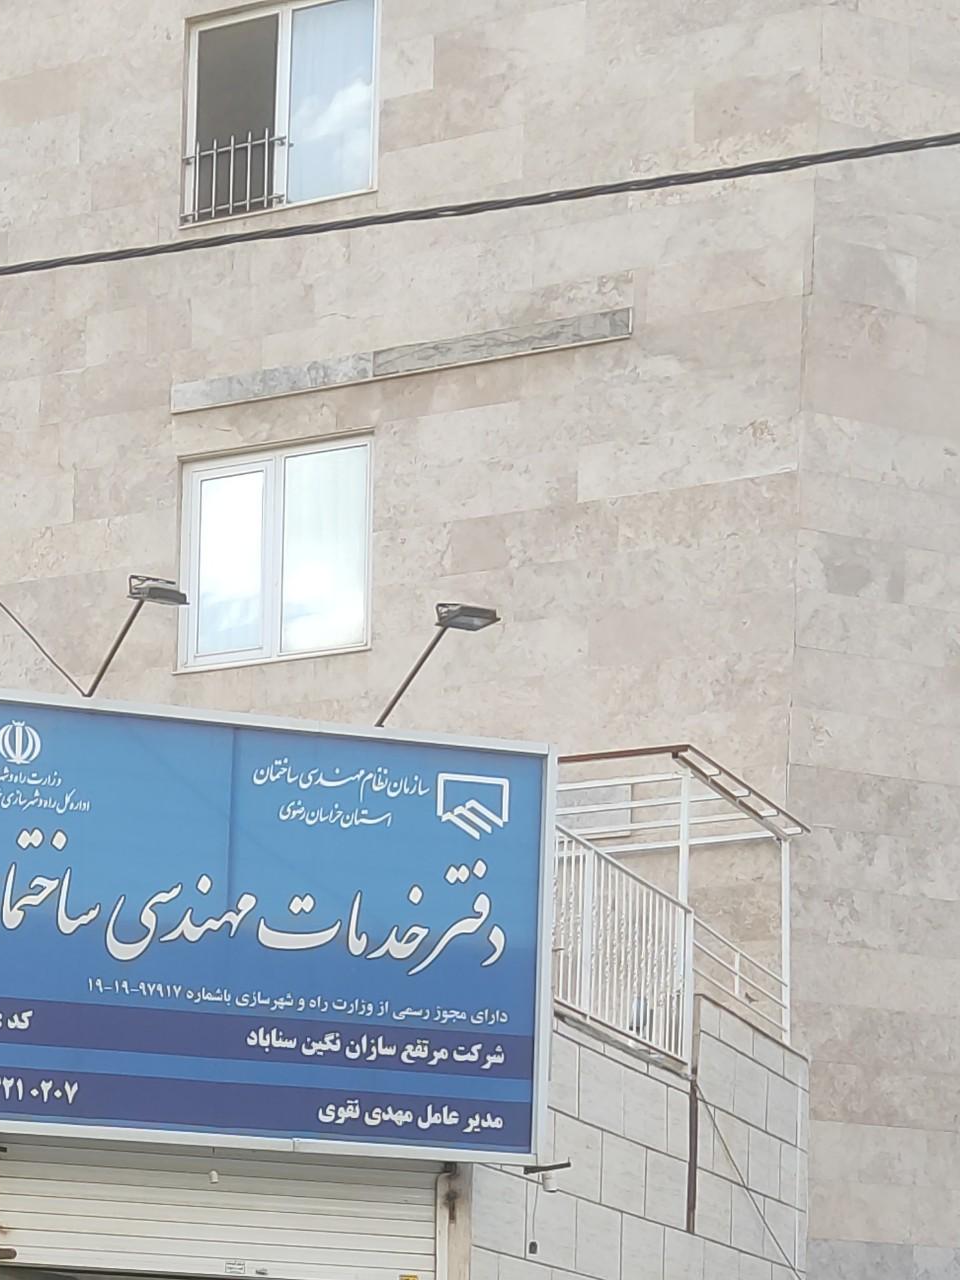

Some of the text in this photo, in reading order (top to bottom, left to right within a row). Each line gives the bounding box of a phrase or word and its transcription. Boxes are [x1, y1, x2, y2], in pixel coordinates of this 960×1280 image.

[253, 758, 430, 803] سازمان نظام مهندسی ساختمان
[279, 800, 391, 828] استان خراسان رضوی
[106, 873, 257, 961] مهندسی
[257, 885, 429, 960] خدمات
[407, 858, 506, 976] دفتر
[297, 997, 305, 1012] و
[309, 996, 329, 1012] راه
[332, 998, 374, 1016] وزارت
[377, 1000, 389, 1016] از
[393, 1005, 430, 1021] رسمی
[434, 1006, 467, 1025] مجوز
[471, 1008, 509, 1025] دارای
[247, 1027, 505, 1069] شرکت مرتفع سازان نگین سناباد
[30, 1080, 79, 1104] ۰۲۰۷
[364, 1105, 414, 1126] مهدی
[417, 1104, 460, 1129] عامل
[462, 1112, 504, 1133] مدیر
